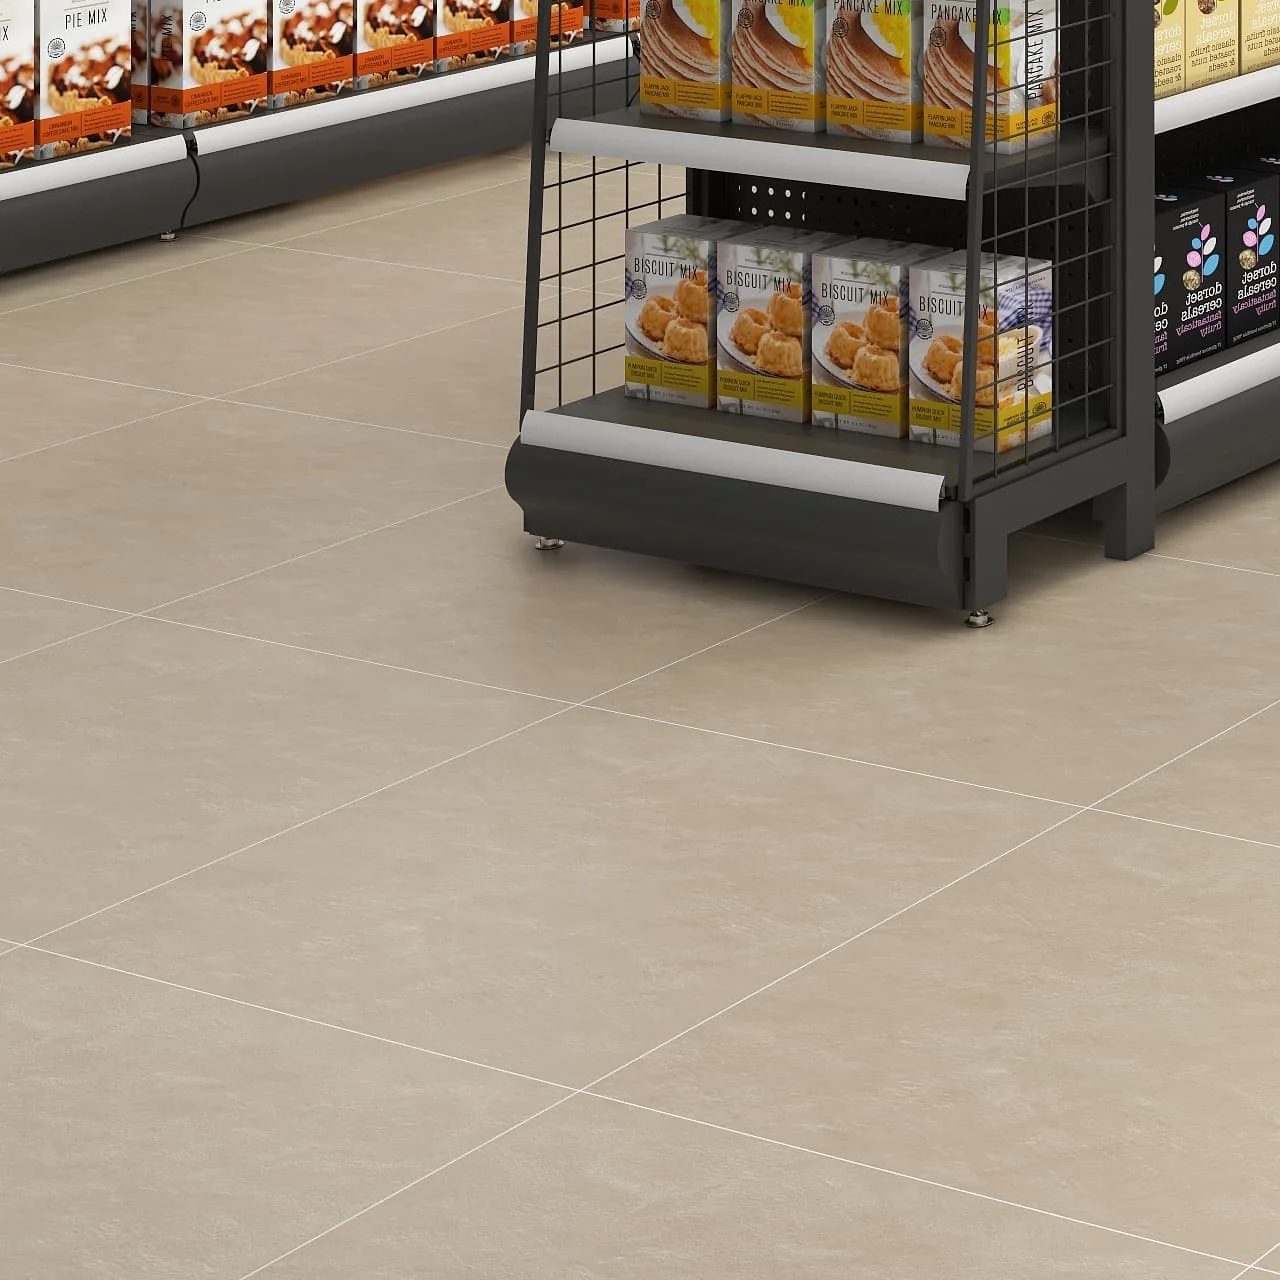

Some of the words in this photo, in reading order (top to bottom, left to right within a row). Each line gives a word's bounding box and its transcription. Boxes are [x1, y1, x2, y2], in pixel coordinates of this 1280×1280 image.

[65, 12, 82, 30] PIE
[88, 8, 107, 26] MIX
[885, 0, 902, 16] MIX
[1028, 9, 1044, 35] MIX
[1027, 38, 1044, 100] PANCAKE
[634, 258, 675, 277] BISCUIT
[680, 264, 698, 280] MIX
[727, 270, 768, 290] BISCUIT
[774, 277, 792, 293] MIX
[821, 283, 864, 304] BISCUIT
[870, 291, 889, 307] MIX
[919, 296, 964, 317] BISCUIT
